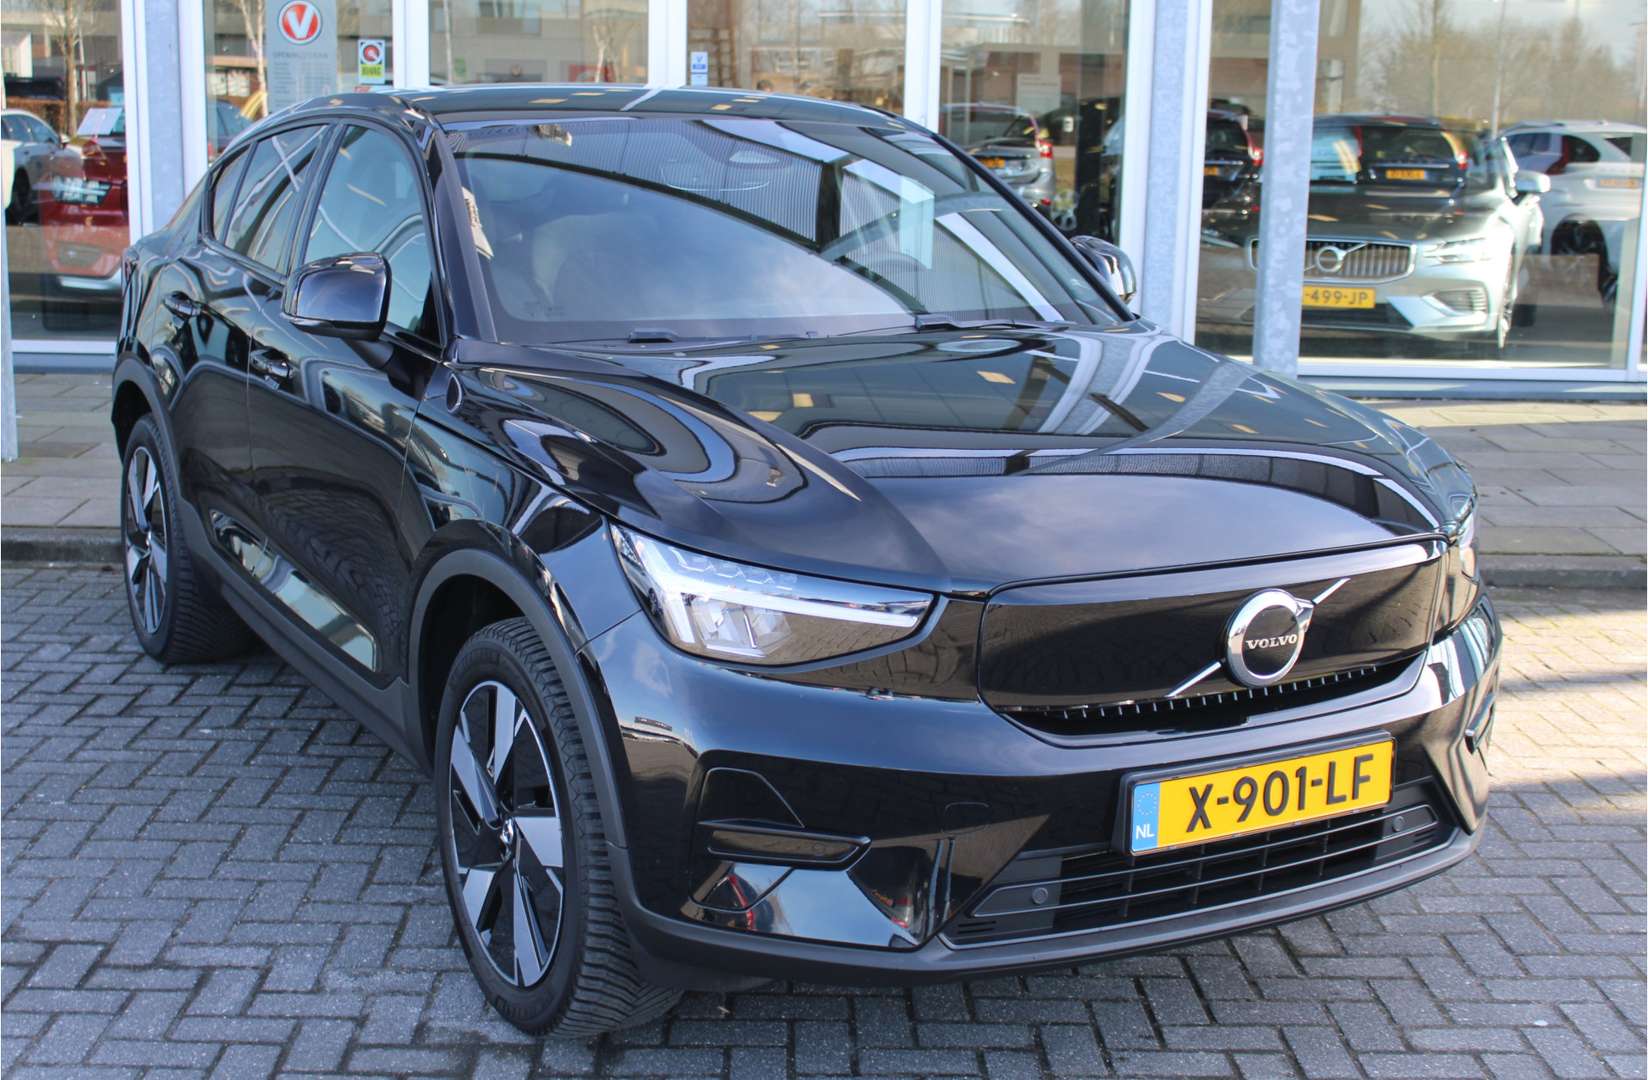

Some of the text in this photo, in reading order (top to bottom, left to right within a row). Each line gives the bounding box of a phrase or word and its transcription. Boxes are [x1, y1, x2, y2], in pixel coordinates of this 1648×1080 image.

[286, 2, 317, 39] V
[1245, 634, 1298, 650] VOLVO
[1135, 754, 1375, 839] NL X-901-LF
